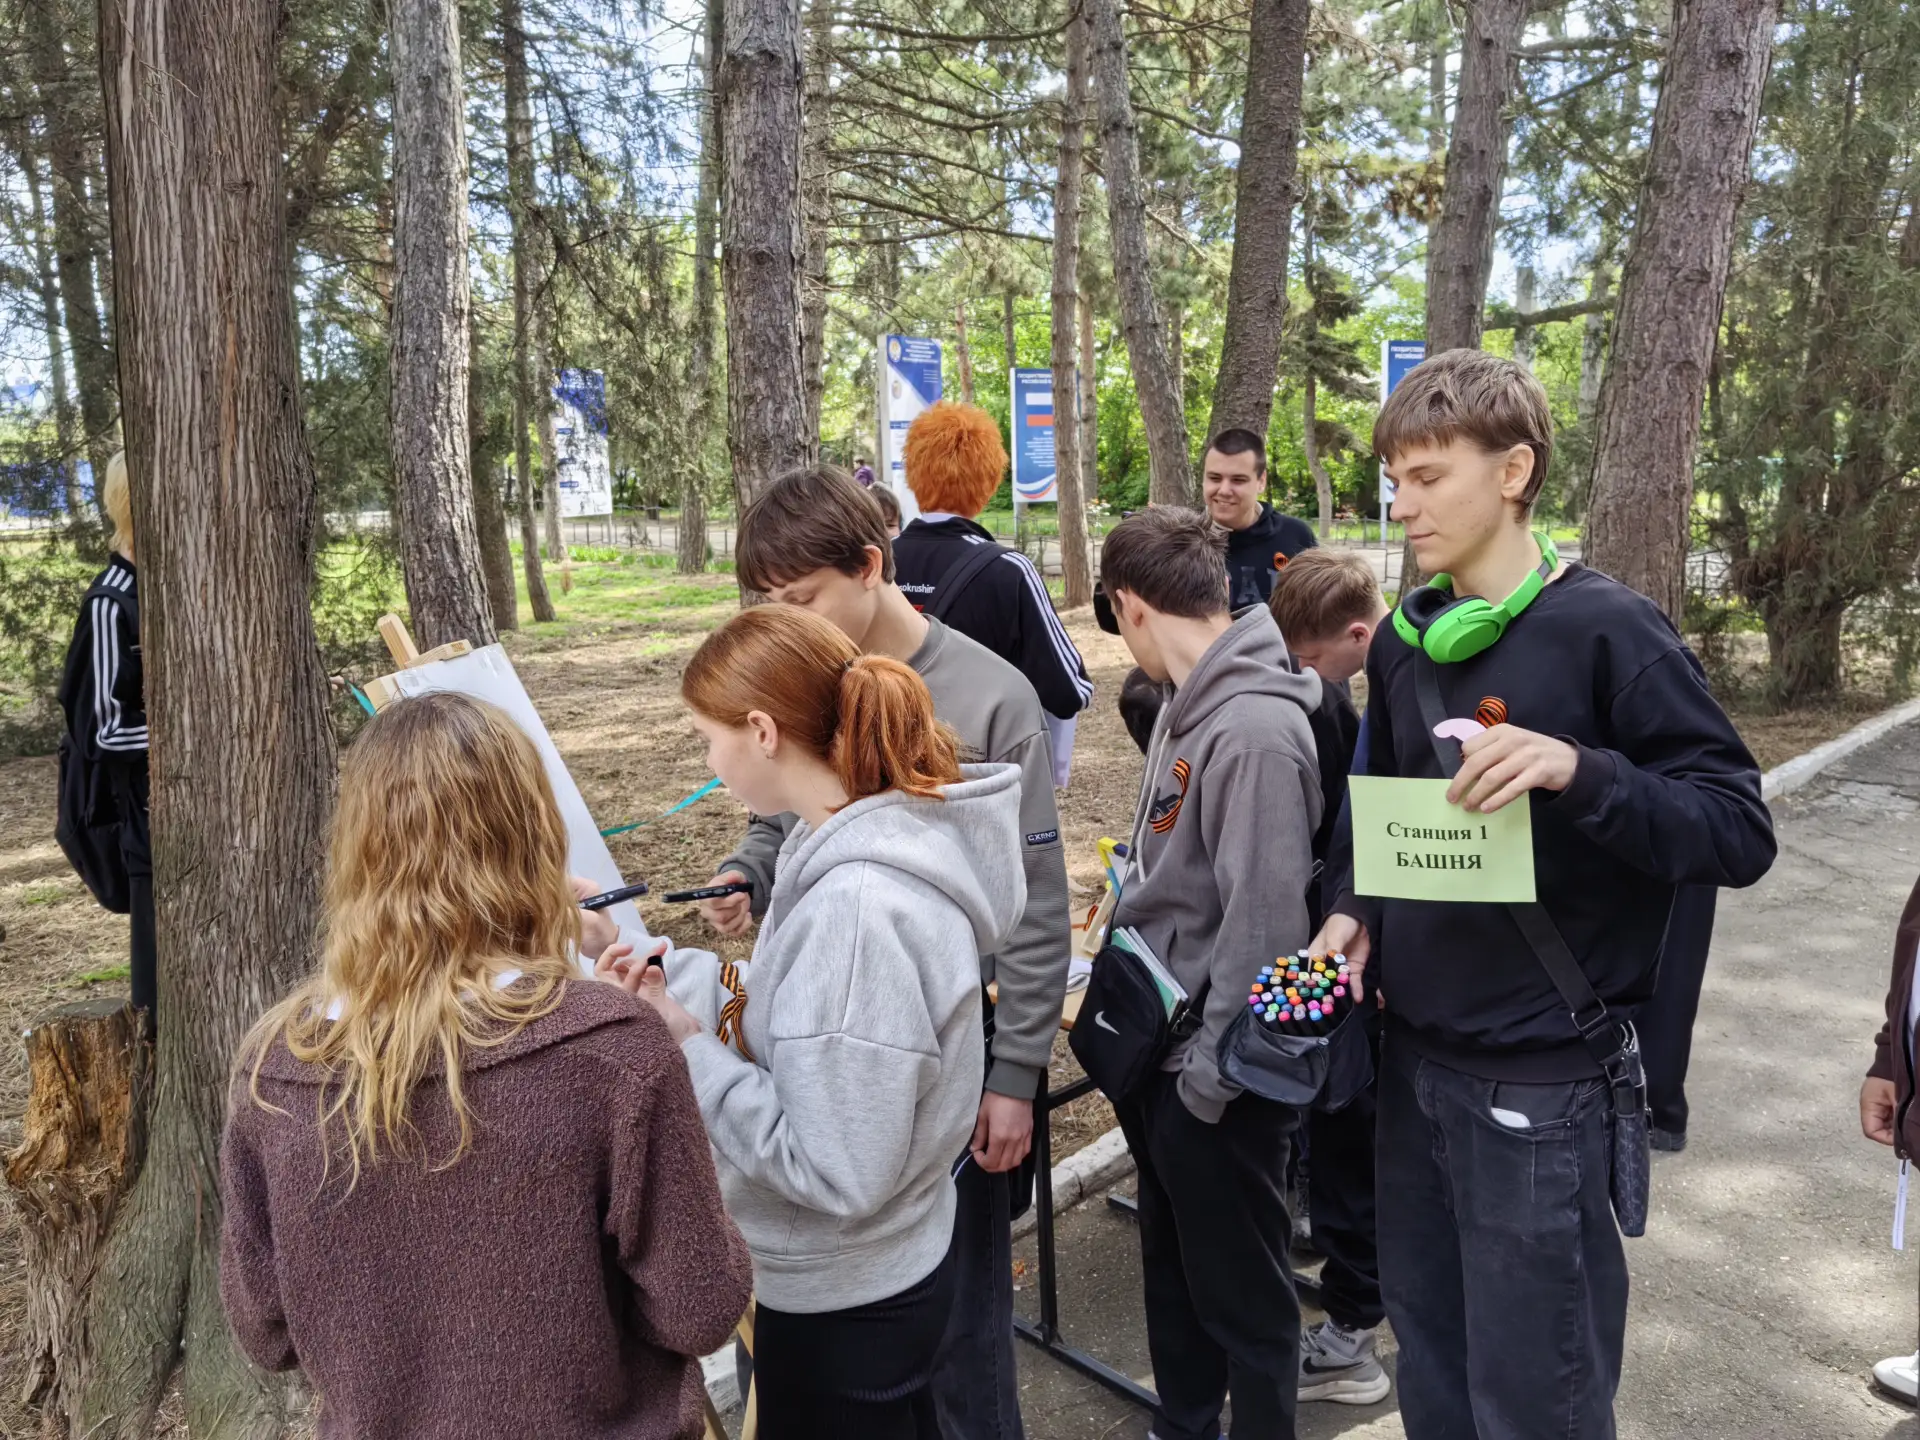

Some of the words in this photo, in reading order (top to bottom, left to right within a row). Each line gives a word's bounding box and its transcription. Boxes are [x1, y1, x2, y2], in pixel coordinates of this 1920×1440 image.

[1387, 822, 1472, 842] Станция
[1480, 825, 1488, 840] 1
[1396, 851, 1482, 869] БАШНЯ
